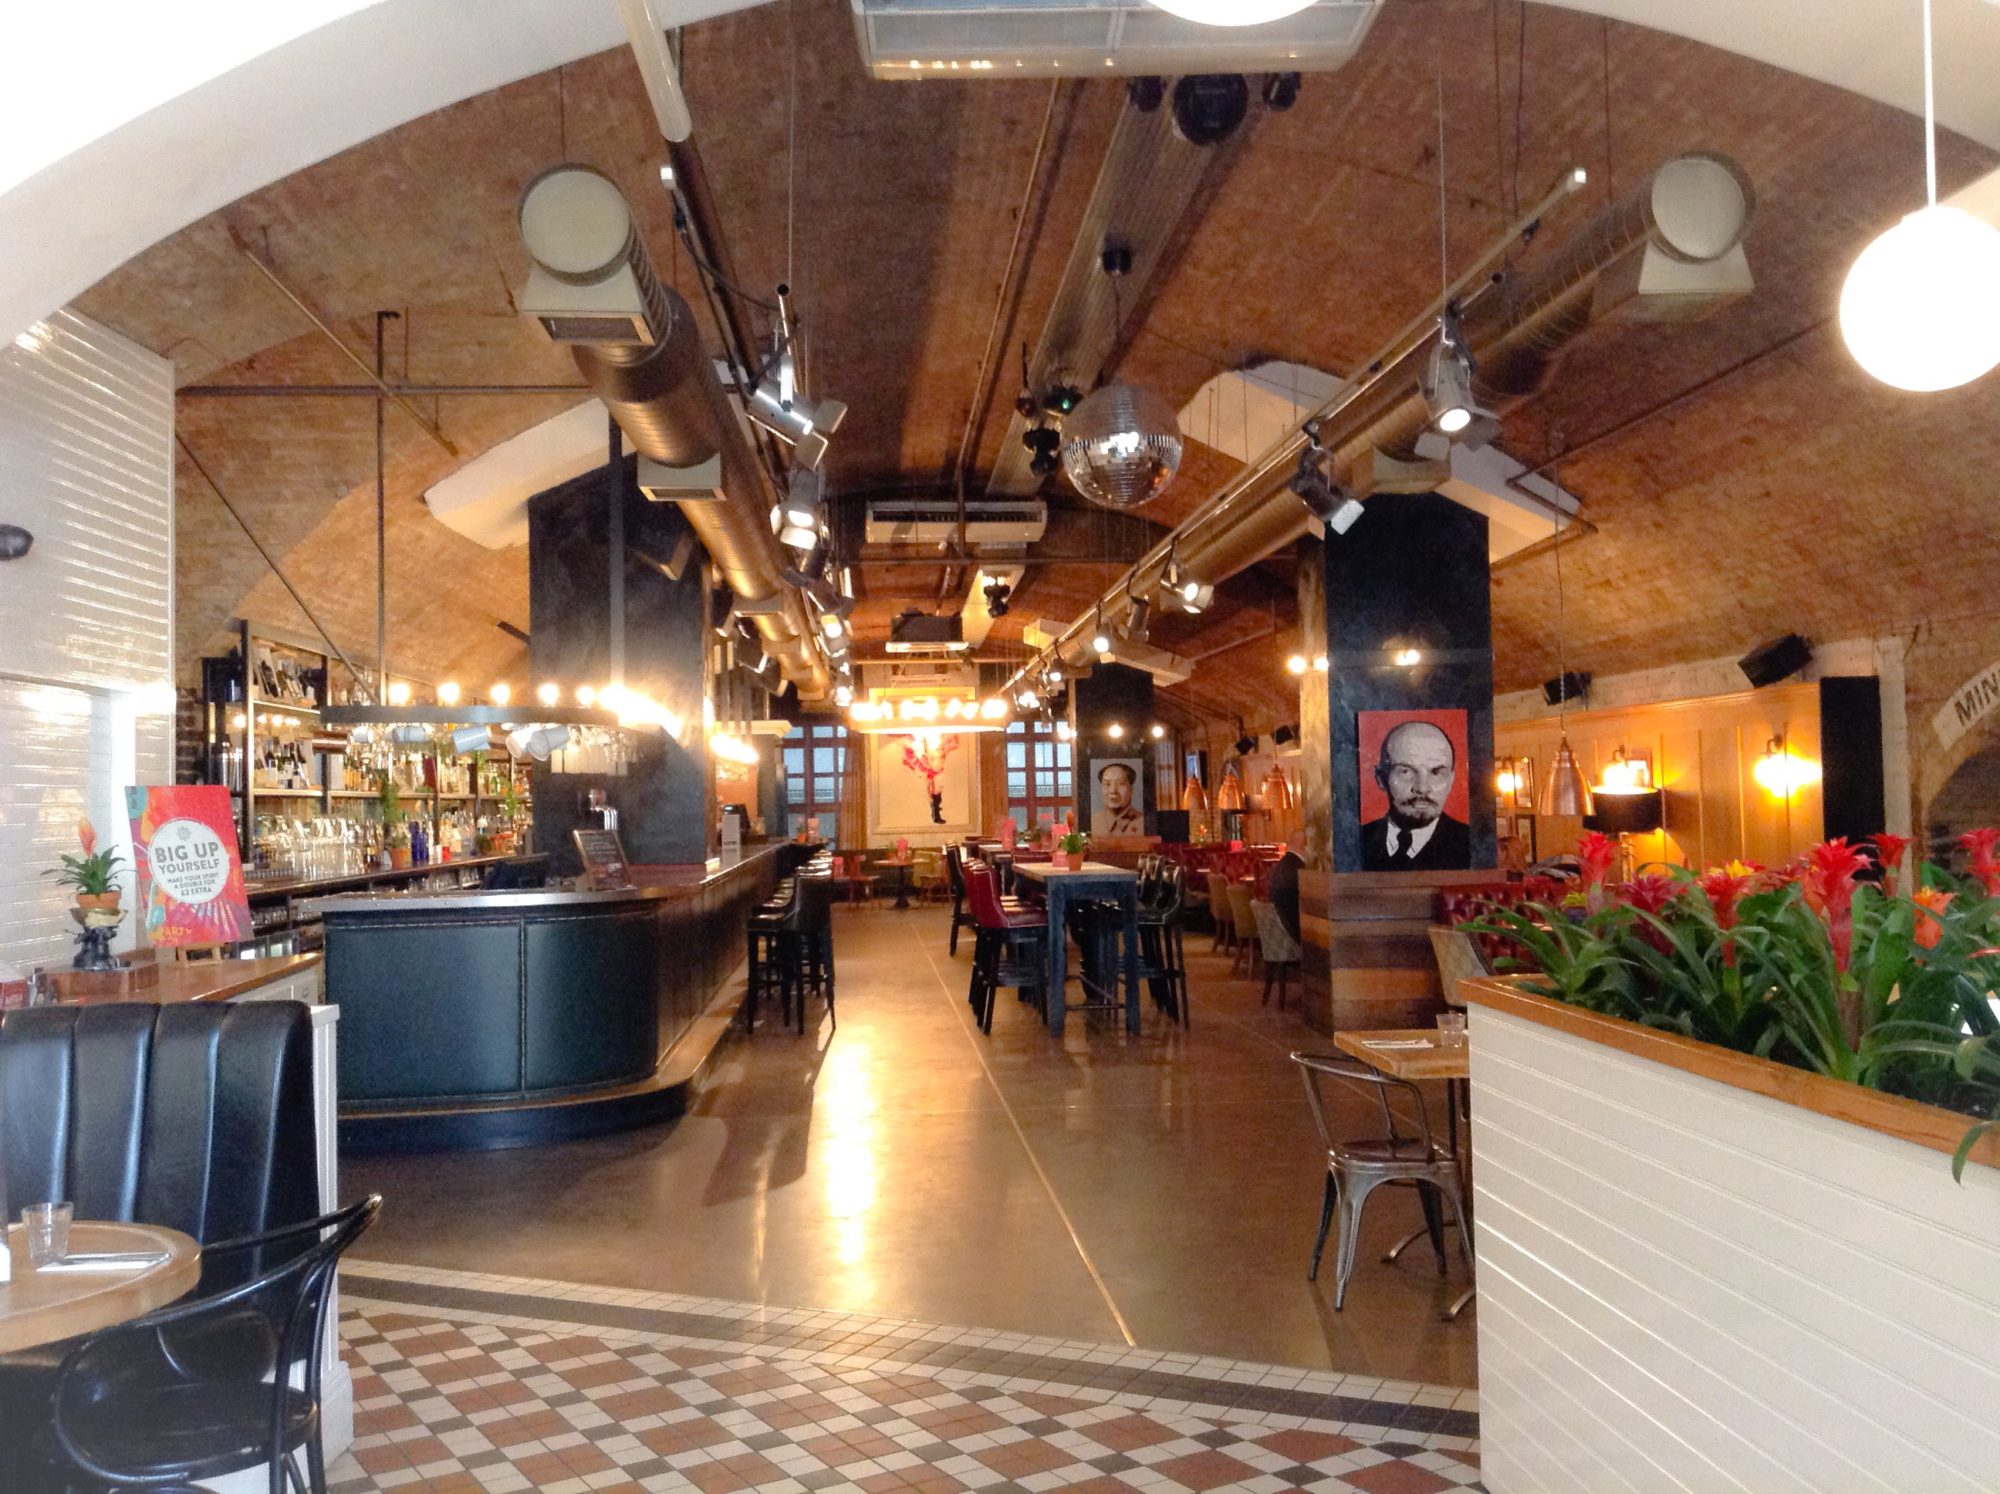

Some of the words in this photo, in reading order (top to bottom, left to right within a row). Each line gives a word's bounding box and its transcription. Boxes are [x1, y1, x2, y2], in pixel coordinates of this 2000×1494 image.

[1954, 669, 2000, 727] MIN
[154, 845, 189, 863] BIG
[193, 841, 219, 858] UP
[158, 858, 220, 875] YOURSELF
[167, 876, 183, 884] MAKE
[184, 874, 202, 882] YOUR
[202, 872, 219, 880] SPIRIT
[180, 880, 203, 889] DOUBLE
[190, 886, 212, 895] EXTRA
